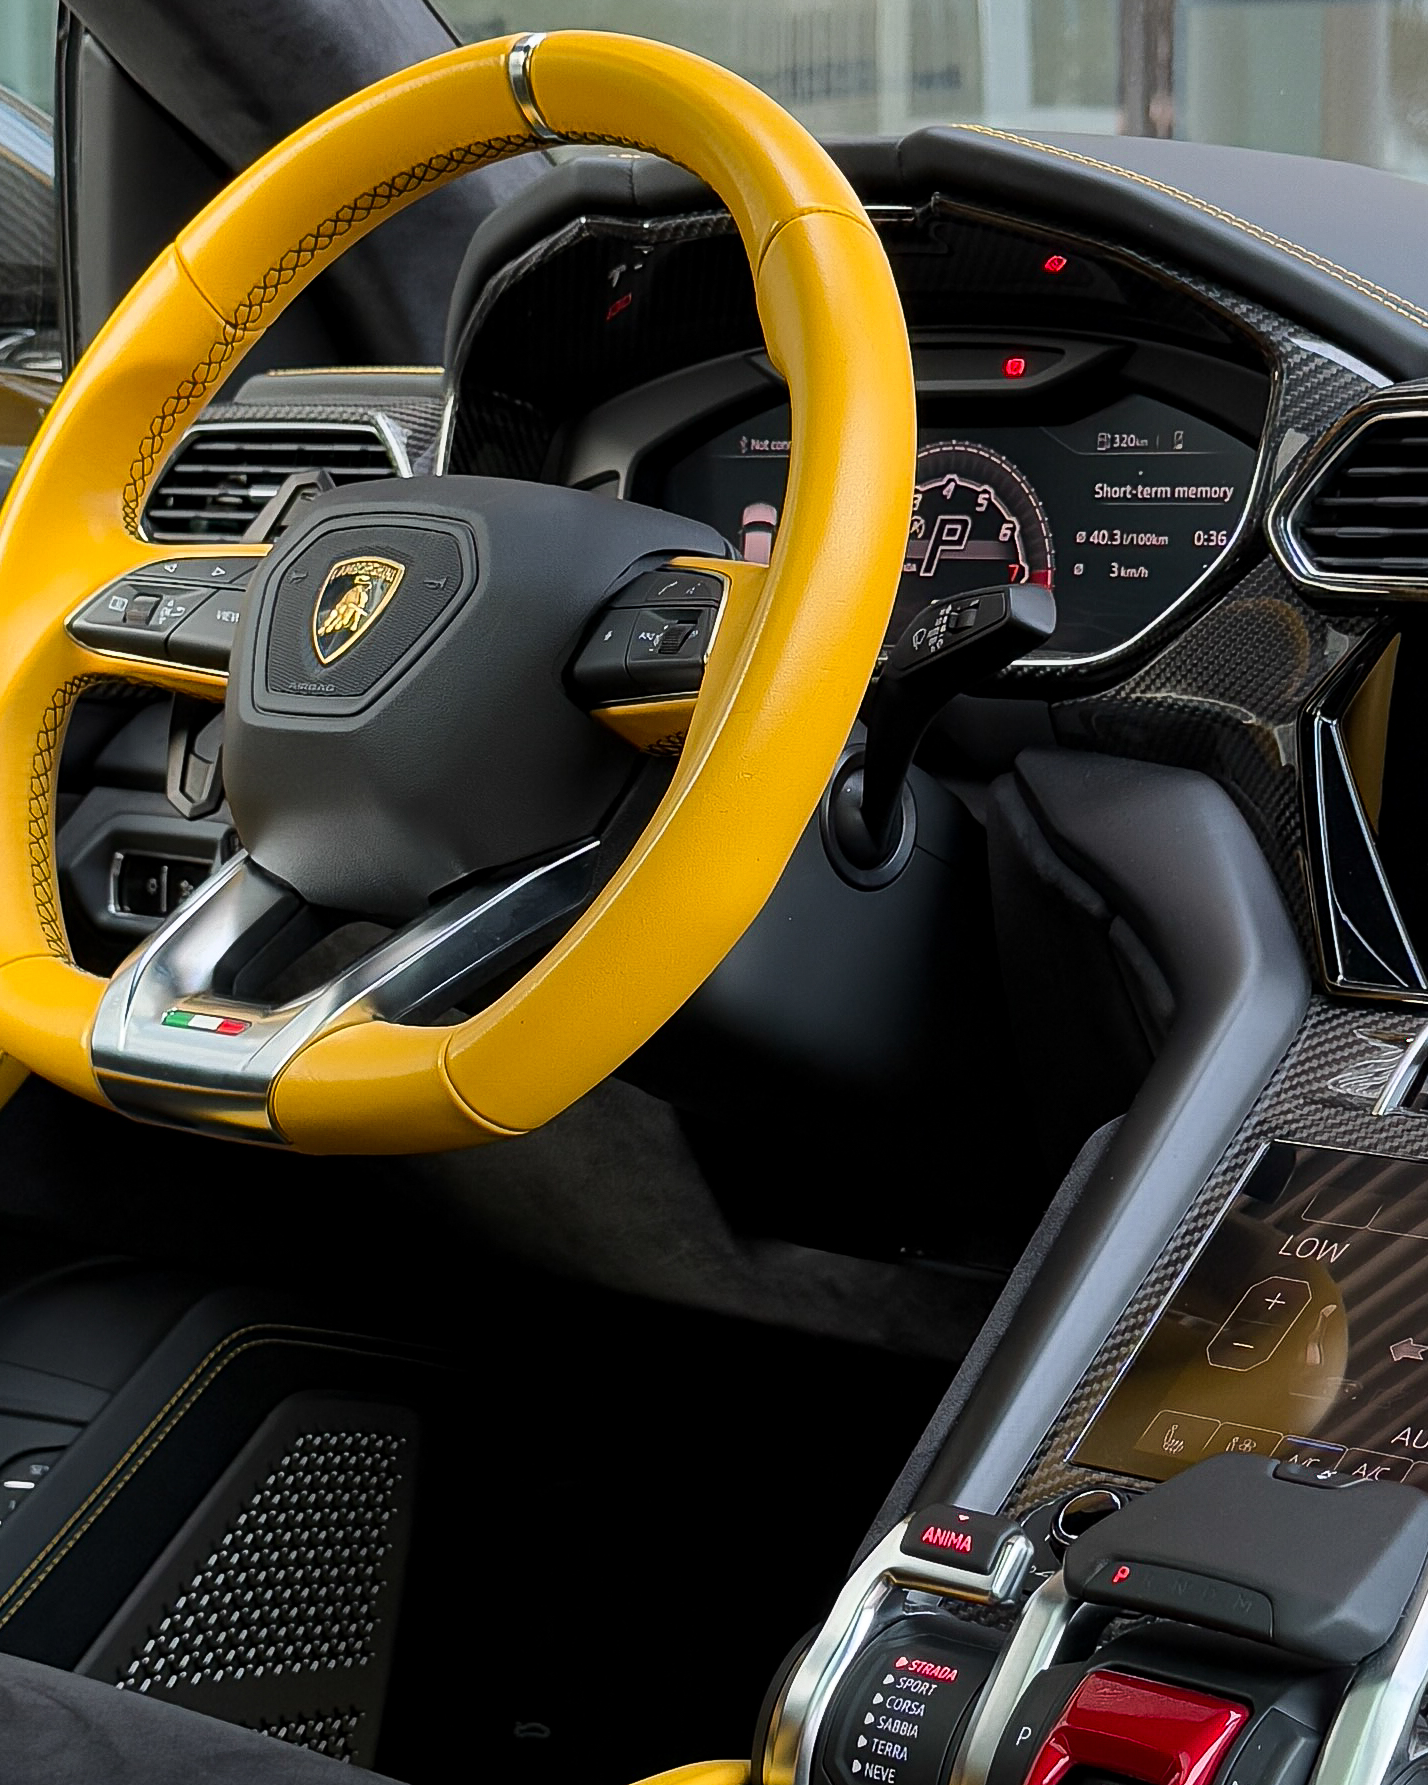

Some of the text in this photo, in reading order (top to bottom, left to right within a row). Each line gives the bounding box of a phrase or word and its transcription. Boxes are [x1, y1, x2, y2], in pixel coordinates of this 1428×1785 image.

[1094, 483, 1234, 502] Short-term memory
[919, 515, 972, 577] P
[975, 494, 990, 512] 5
[999, 523, 1013, 542] 6
[1009, 564, 1020, 582] 7
[1194, 531, 1228, 546] 0:36
[1278, 1234, 1351, 1264] LOW
[922, 1525, 973, 1553] ANIMA
[1112, 1565, 1131, 1584] P
[907, 1659, 959, 1682] STRADA
[896, 1677, 938, 1697] SPORT
[885, 1695, 926, 1717] CORSA
[876, 1716, 919, 1739] SABBIA
[1015, 1726, 1032, 1746] P
[871, 1738, 909, 1762] TERRA
[864, 1761, 897, 1785] NEVE
